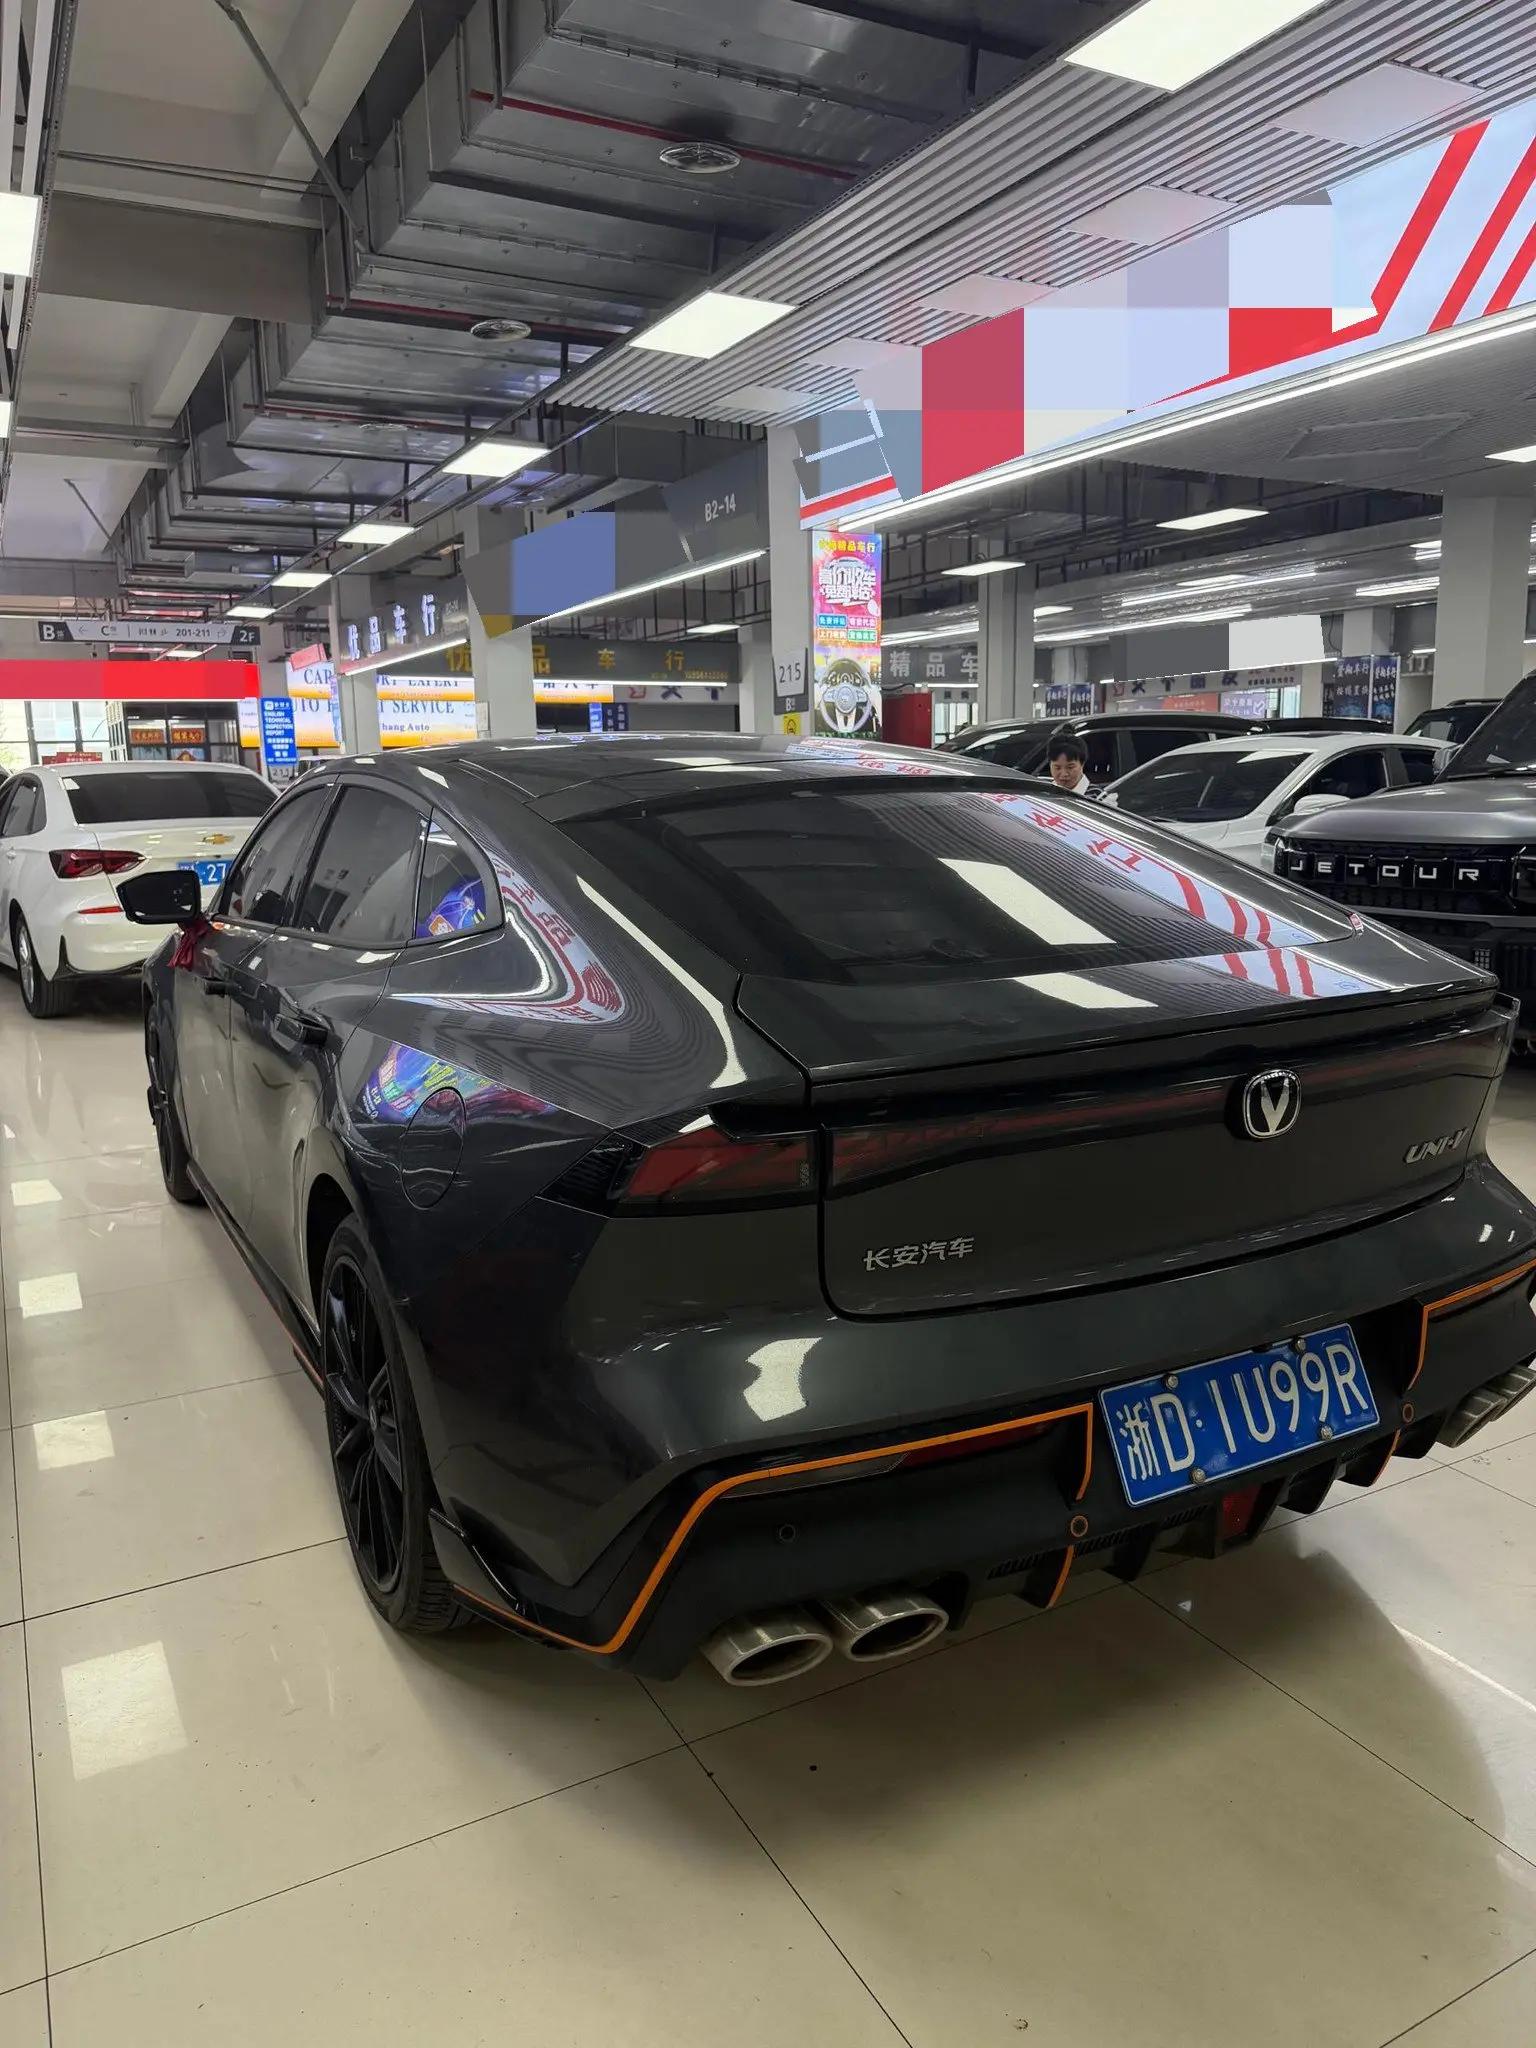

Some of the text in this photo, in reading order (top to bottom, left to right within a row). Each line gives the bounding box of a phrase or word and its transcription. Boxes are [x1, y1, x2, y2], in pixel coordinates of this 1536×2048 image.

[704, 493, 737, 522] B2-14
[175, 628, 212, 638] 201-211
[779, 662, 801, 684] 215
[392, 701, 455, 714] SERVICE
[408, 722, 430, 731] Auto
[1290, 862, 1480, 882] JETOUR
[863, 1237, 975, 1271] 长安汽车
